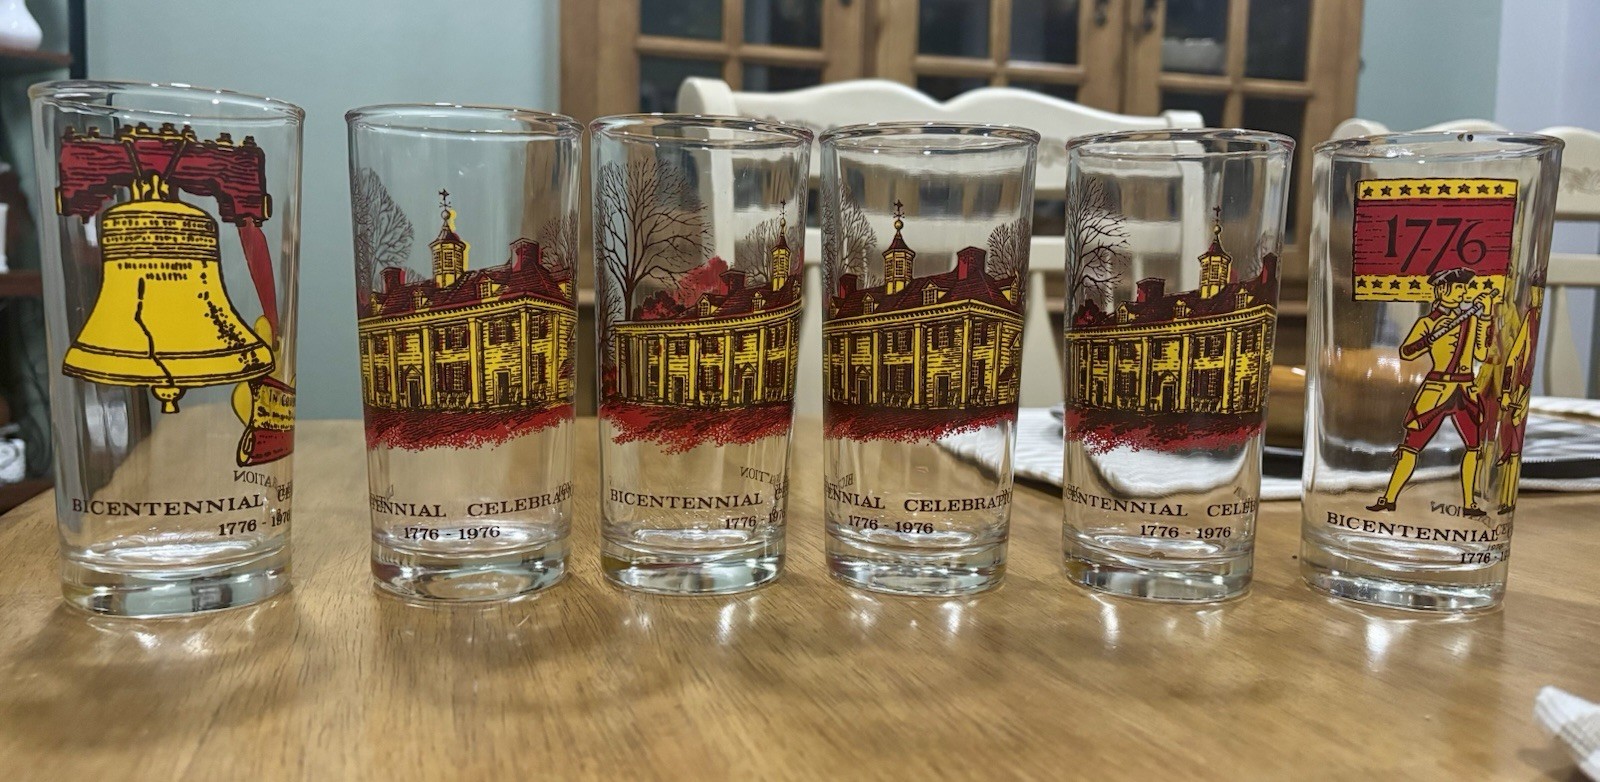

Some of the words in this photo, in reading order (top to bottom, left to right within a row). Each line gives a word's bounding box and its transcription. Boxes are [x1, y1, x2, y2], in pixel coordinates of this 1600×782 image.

[1384, 215, 1487, 275] 1776
[72, 495, 264, 516] BICENTENNIAL
[610, 488, 764, 509] BICENTENNIAL
[218, 519, 257, 536] 1776
[725, 516, 757, 530] 1776
[848, 515, 878, 531] 1776
[895, 521, 933, 535] 1976
[1140, 524, 1179, 539] 1776
[1196, 526, 1231, 539] 1976
[1326, 511, 1499, 542] BICENTENNIAL
[404, 527, 439, 540] 1776
[459, 525, 500, 541] 1976
[1461, 552, 1491, 564] 1776
